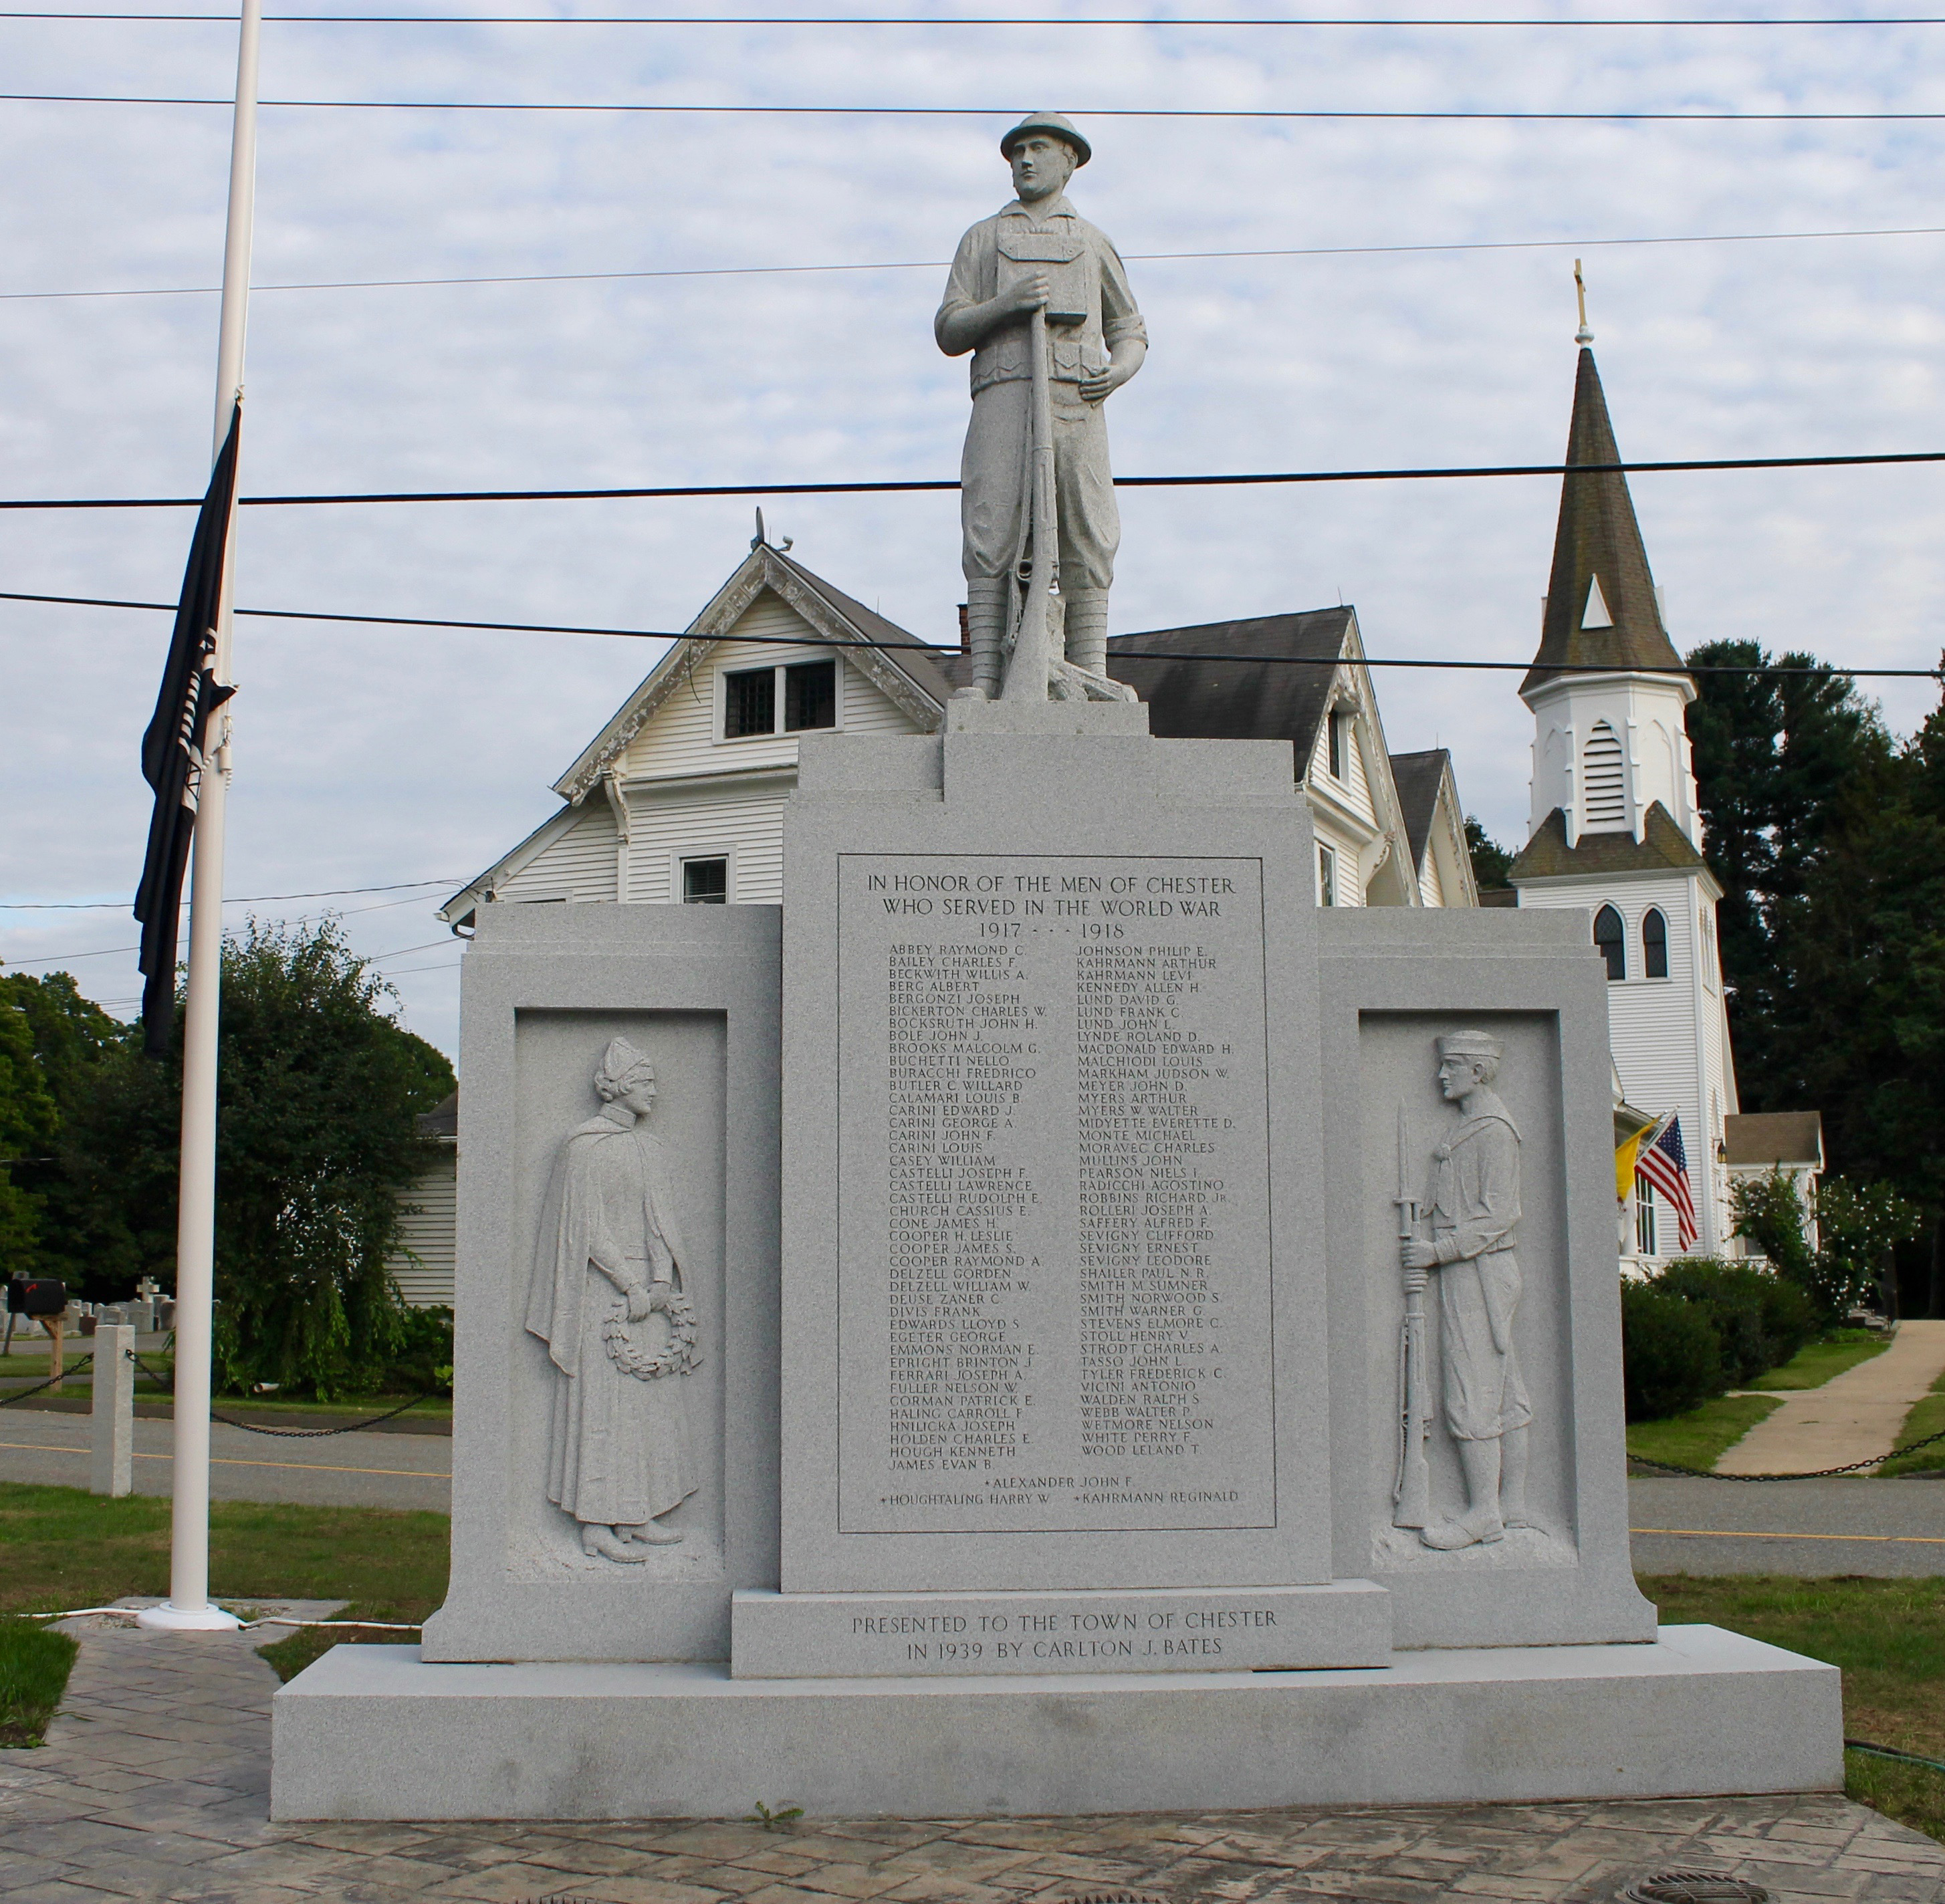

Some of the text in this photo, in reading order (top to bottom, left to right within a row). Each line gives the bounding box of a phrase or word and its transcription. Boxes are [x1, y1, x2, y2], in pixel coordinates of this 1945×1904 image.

[868, 875, 1236, 894] IN HONOR OF THE MEN OF CHESTER
[883, 899, 1222, 917] WHO SERVED IN THE WORLD WAR
[980, 922, 1125, 939] 1917 1918
[889, 945, 933, 955] ABBEY
[939, 945, 1008, 955] RAYMOND
[1076, 946, 1207, 957] JOHNSON PHILIP E.
[889, 957, 935, 967] BAILEY
[942, 957, 1002, 967] CHARLES
[1076, 958, 1216, 969] KAHRMANN ARTHUR
[889, 969, 1028, 979] BECKWITH WILLIS A.
[1076, 971, 1192, 981] KAHRMANN LEVI
[889, 981, 980, 992] BERG ALBERT
[889, 993, 1020, 1004] BERGONZI JOSEPH
[889, 1006, 1047, 1017] BICKERTON CHARLES W.
[1077, 1007, 1183, 1018] LUND FRANK C.
[889, 1018, 1038, 1029] BOCKSRUTH JOHN H.
[1077, 1020, 1175, 1030] LUND JOHN L.
[889, 1031, 983, 1041] BOLE JOHN J.
[1078, 1032, 1200, 1042] LYNDE ROLAND D.
[889, 1043, 1040, 1054] BROOKS MALCOLM G.
[1077, 1044, 1234, 1054] MACDONALD EDWARD H.
[889, 1056, 1009, 1066] BUCHETTI NELLO
[1078, 1056, 1202, 1066] MALCHIODI LOUIS
[889, 1068, 1036, 1078] BURACCHI FREDRICO
[1078, 1081, 1187, 1092] MEYER JOHN D.
[1078, 1094, 1187, 1104] MYERS ARTHUR
[1078, 1118, 1236, 1128] MIDYETTE EVERETTE D.
[1078, 1130, 1195, 1141] MONTE MICHAEL
[889, 1143, 983, 1153] CARINI LOUIS
[1079, 1143, 1215, 1154] MORAVEC CHARLES
[889, 1156, 996, 1166] CASEY WILLIAM
[1079, 1156, 1182, 1166] MULLINS JOHN
[889, 1181, 1032, 1191] CASTELLI LAWRENCE
[1079, 1180, 1224, 1191] RADICCHI AGOSTINO
[889, 1193, 1042, 1203] CASTELLI RUDOLPH E.
[889, 1205, 1030, 1216] CHURCH CASSIUS E.
[1080, 1205, 1212, 1216] ROLLERI JOSEPH A.
[1079, 1230, 1214, 1241] SEVIGNY CLIFFORD
[889, 1243, 1016, 1254] COOPER JAMES S.
[1079, 1243, 1198, 1254] SEVIGNY ERNEST
[1080, 1256, 1211, 1266] SEVIGNY LEODORE
[890, 1269, 1011, 1280] DELZELL GORDEN
[890, 1307, 980, 1317] DIVIS FRANK
[890, 1332, 1006, 1342] EGETER GEORGE
[890, 1344, 1039, 1355] EMMONS NORMAN E.
[1080, 1343, 1223, 1354] STRODT CHARLES A.
[1081, 1381, 1196, 1392] VICINI ANTONIO
[890, 1395, 1036, 1406] GORMAN PATRICK E.
[890, 1421, 1015, 1432] HNILICKA JOSEPH
[1081, 1419, 1214, 1430] WETMORE NELSON
[890, 1447, 1016, 1457] HOUGH KENNETH
[889, 1460, 935, 1470] JAMES
[942, 1460, 976, 1470] EVAN
[993, 1477, 1074, 1488] ALEXANDER
[1080, 1477, 1119, 1488] JOHN
[890, 1494, 984, 1506] HOUGHTALING
[990, 1494, 1032, 1504] HARRY
[1082, 1492, 1239, 1504] KAHRMANN REGINALD
[852, 1611, 1278, 1634] PRESENTED TO THE TOWN OF CHESTER
[907, 1638, 1222, 1660] IN 1939 BY CARLTON J. BATES
